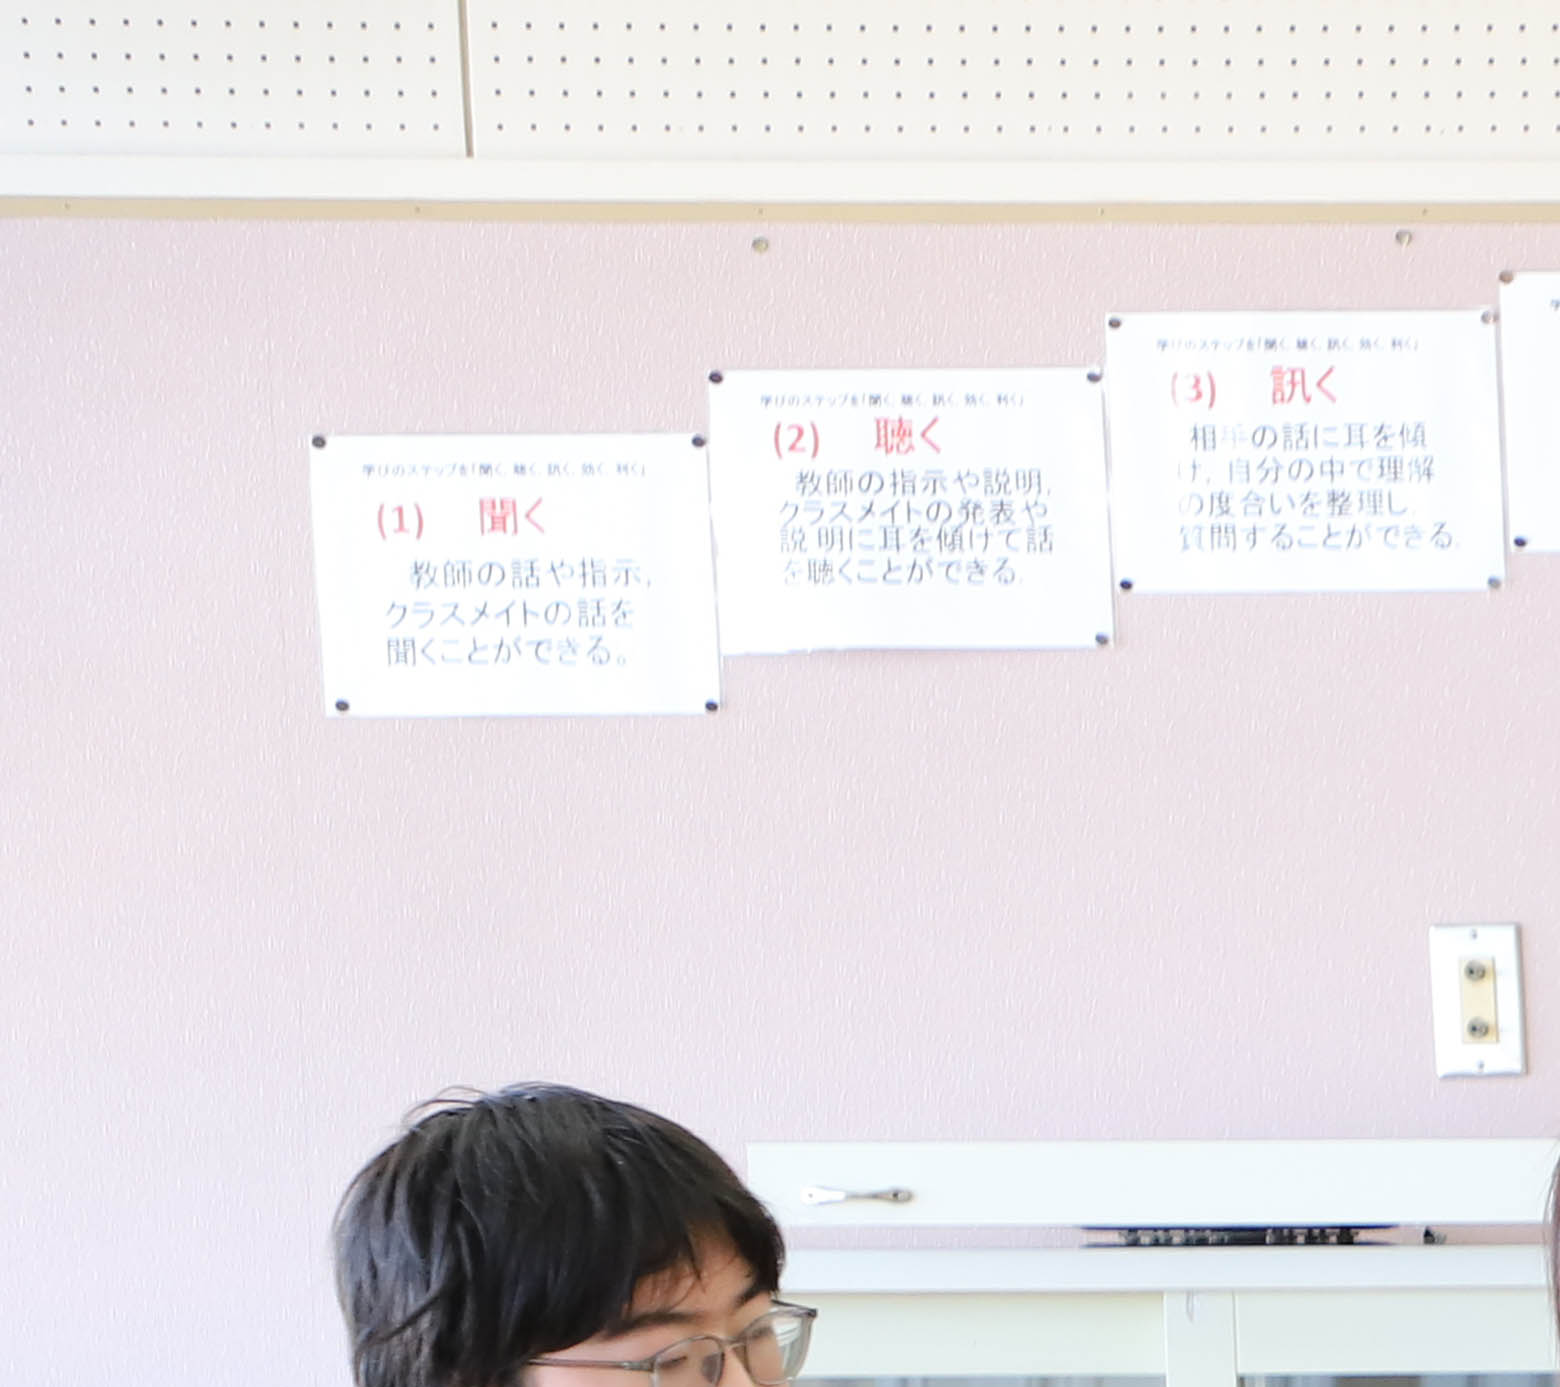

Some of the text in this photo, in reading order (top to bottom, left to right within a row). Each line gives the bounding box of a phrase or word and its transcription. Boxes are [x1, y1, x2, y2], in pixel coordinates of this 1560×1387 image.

[1171, 365, 1337, 410] (3) 訊く
[773, 416, 942, 459] (2) 聴く
[1190, 422, 1427, 451] 相手の話に耳を傾
[377, 497, 546, 540] (1) 聞く
[779, 499, 1049, 526] クラスメイトの発表や
[779, 526, 1054, 554] 説明に耳を傾けて話
[385, 599, 634, 628] クラスメイトの話を
[387, 636, 627, 668] 聞くことができる。
